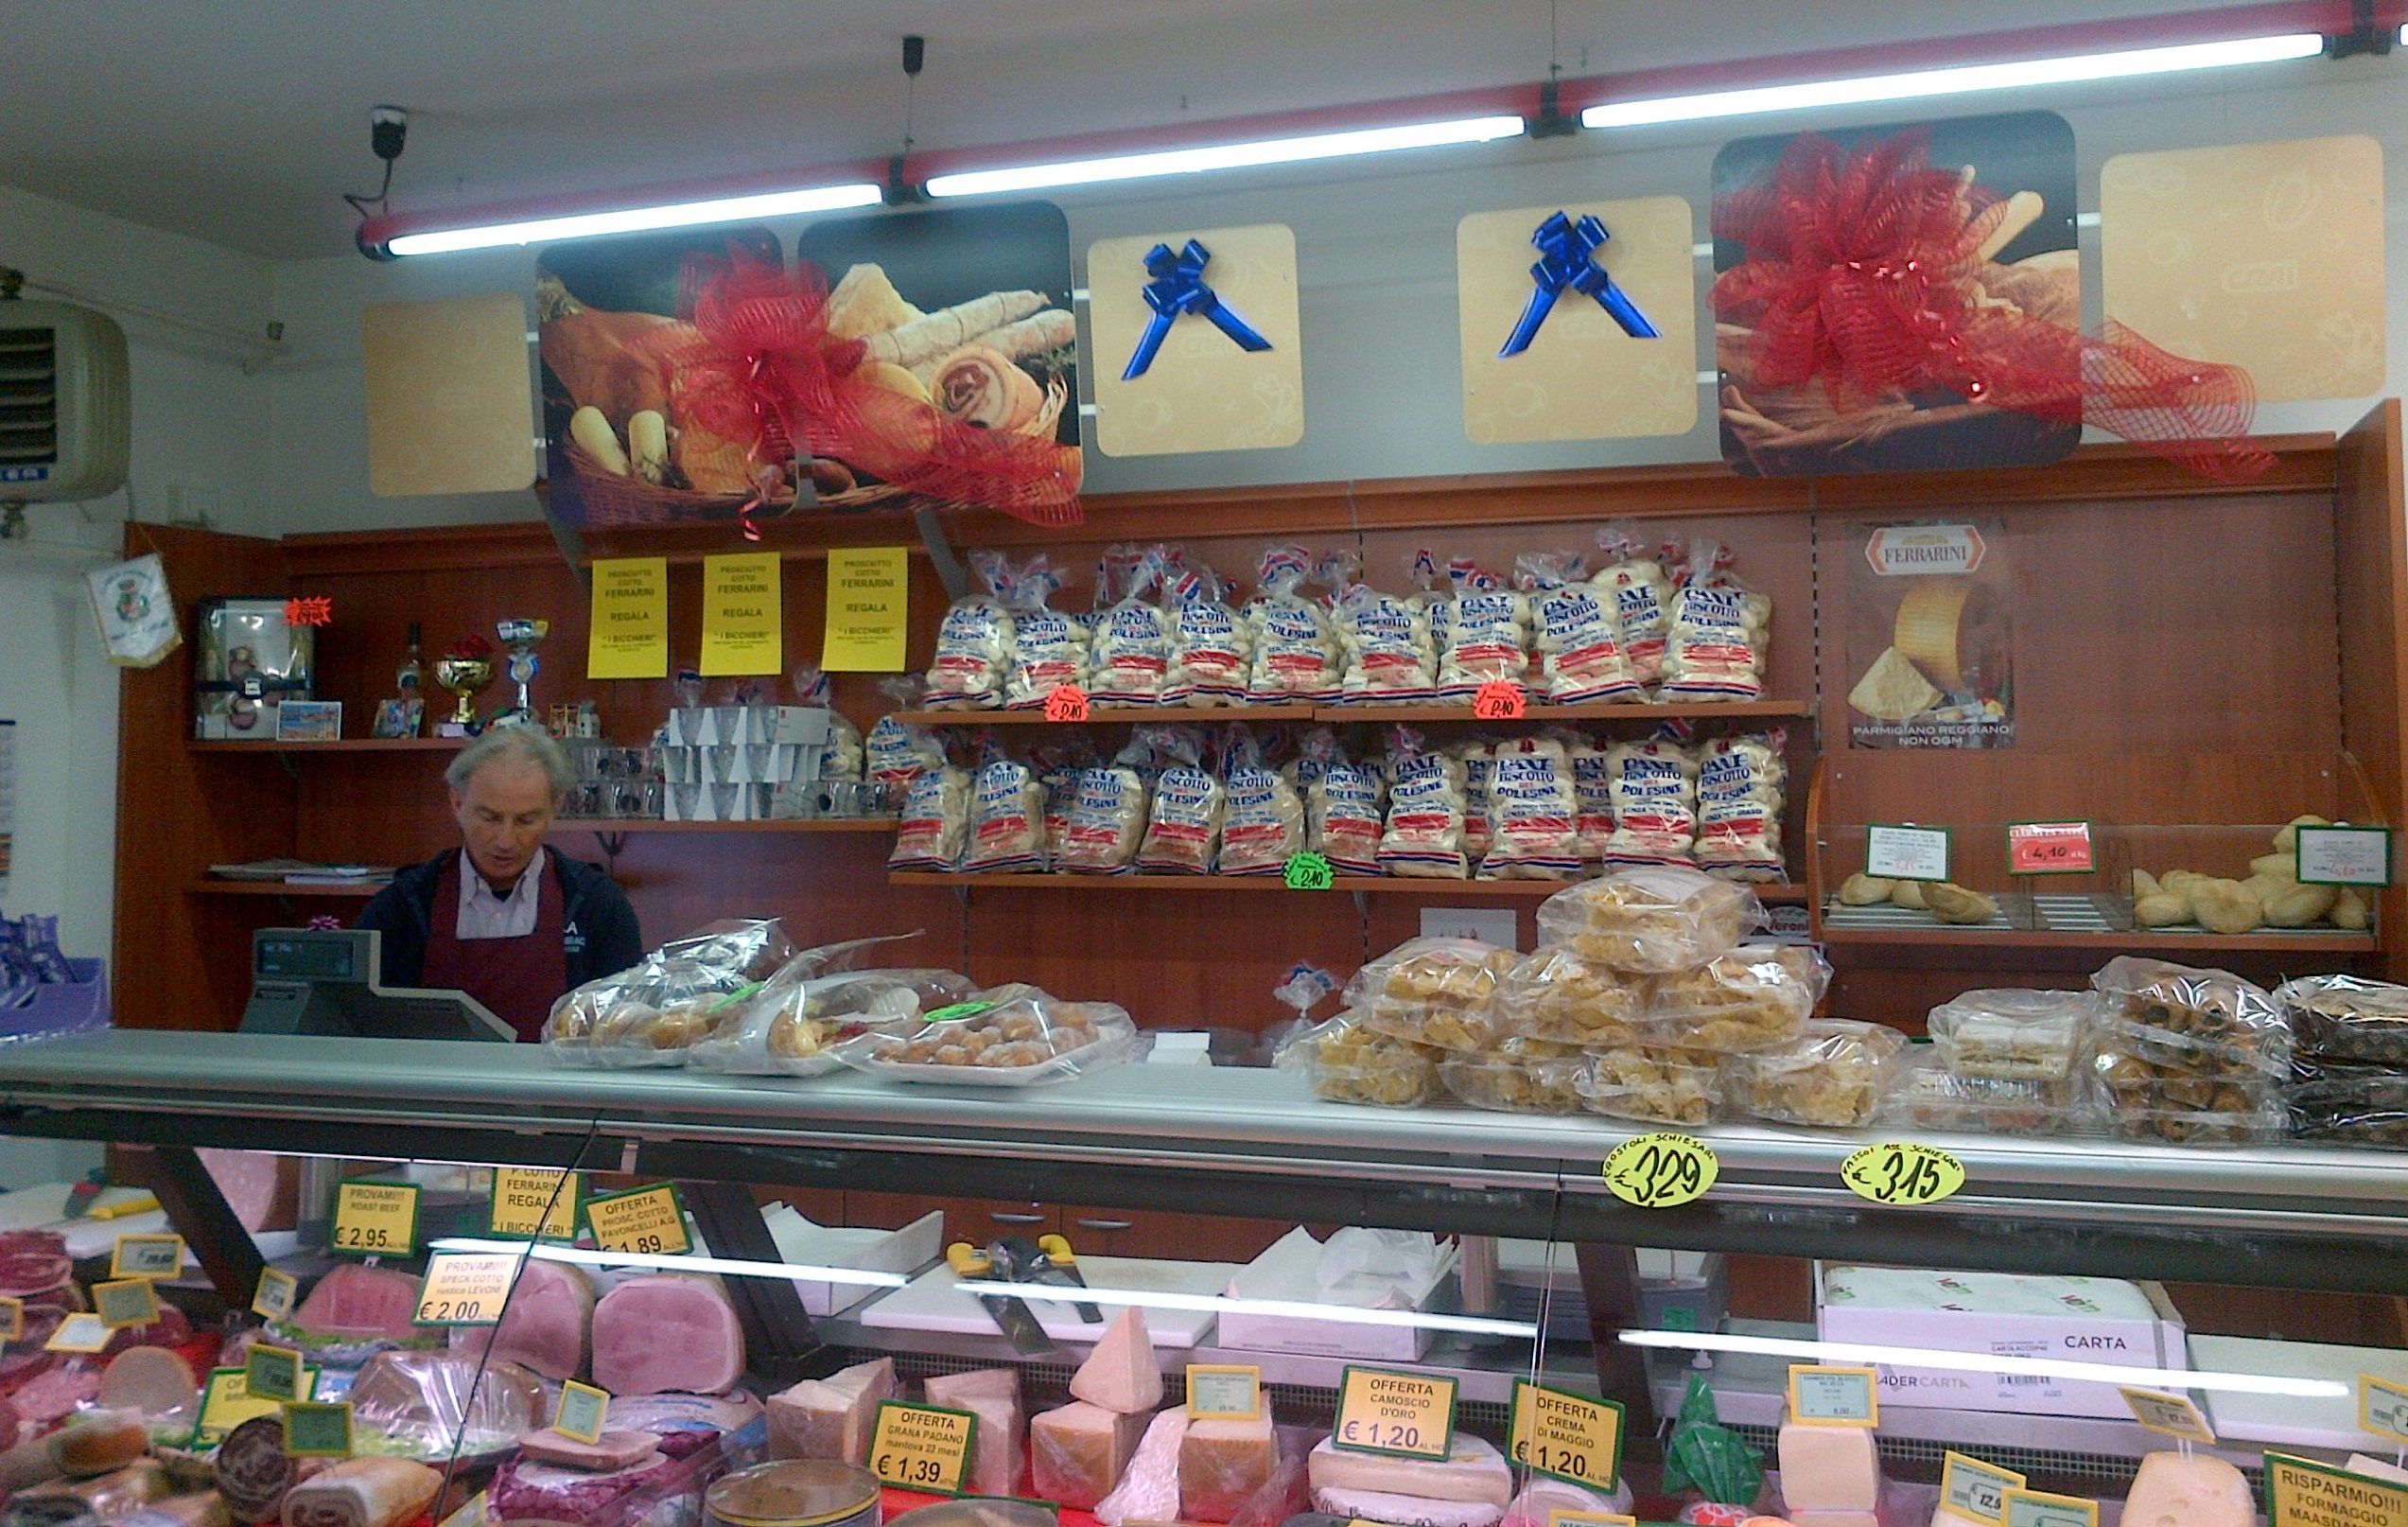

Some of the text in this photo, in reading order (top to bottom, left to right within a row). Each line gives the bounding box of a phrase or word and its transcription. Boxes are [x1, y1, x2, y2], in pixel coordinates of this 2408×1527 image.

[1884, 545, 1967, 564] FERRARINI
[718, 584, 769, 594] FERRARINI
[841, 578, 895, 588] FERRARINI
[605, 588, 655, 599] FERRARINI
[610, 611, 650, 622] REGALA
[723, 607, 763, 618] REGALA
[846, 603, 887, 613] REGALA
[1266, 622, 1318, 640] POLESINE
[1853, 725, 2009, 735] PARMIGIANO REGGIANO
[1899, 735, 1963, 746] NON OGM
[1395, 755, 1443, 776] PANE
[1499, 758, 1553, 771] PANE
[1623, 758, 1681, 771] PANE
[1701, 752, 1749, 775] PANE
[1498, 770, 1555, 782] BISCOTTO
[1624, 770, 1682, 781] BISCOTTO
[1701, 767, 1751, 786] BISCOTTO
[1393, 781, 1443, 797] POLESINE
[1496, 786, 1558, 799] POLESINE
[1621, 783, 1684, 796] POLESINE
[1701, 782, 1754, 801] POLESINE
[507, 1179, 565, 1193] FERRARIN
[351, 1202, 400, 1213] ROAST BEEF
[605, 1195, 657, 1215] OFFERTA
[637, 1206, 669, 1220] COTTO
[506, 1221, 565, 1236] BICCERI
[601, 1219, 657, 1239] PAVONCELLI
[335, 1226, 388, 1249] € 2,95
[440, 1273, 504, 1284] SPECK COTTO
[419, 1301, 480, 1321] € 2,00
[2064, 1335, 2126, 1351] CARTA
[1370, 1378, 1434, 1396] OFFERTA
[1370, 1393, 1431, 1409] CAMOSCIO
[1537, 1395, 1598, 1422] OFFERTA
[901, 1411, 955, 1430] OFFERTA
[1380, 1406, 1417, 1420] D'ORO
[1546, 1414, 1586, 1433] CREMA
[887, 1425, 964, 1445] GRANA PADANO
[1343, 1420, 1359, 1441] €
[1369, 1422, 1419, 1448] 1,20
[1537, 1427, 1595, 1449] DI MAGGIO
[885, 1439, 923, 1452] mantova
[937, 1446, 961, 1457] mesi
[1514, 1440, 1529, 1463] €
[1537, 1447, 1587, 1478] 1,20
[877, 1454, 941, 1483] € 1,39
[2281, 1469, 2401, 1515] RISPARMIO!!!
[2289, 1507, 2365, 1527] MAASD
[2297, 1492, 2388, 1526] FORMAGGIO
